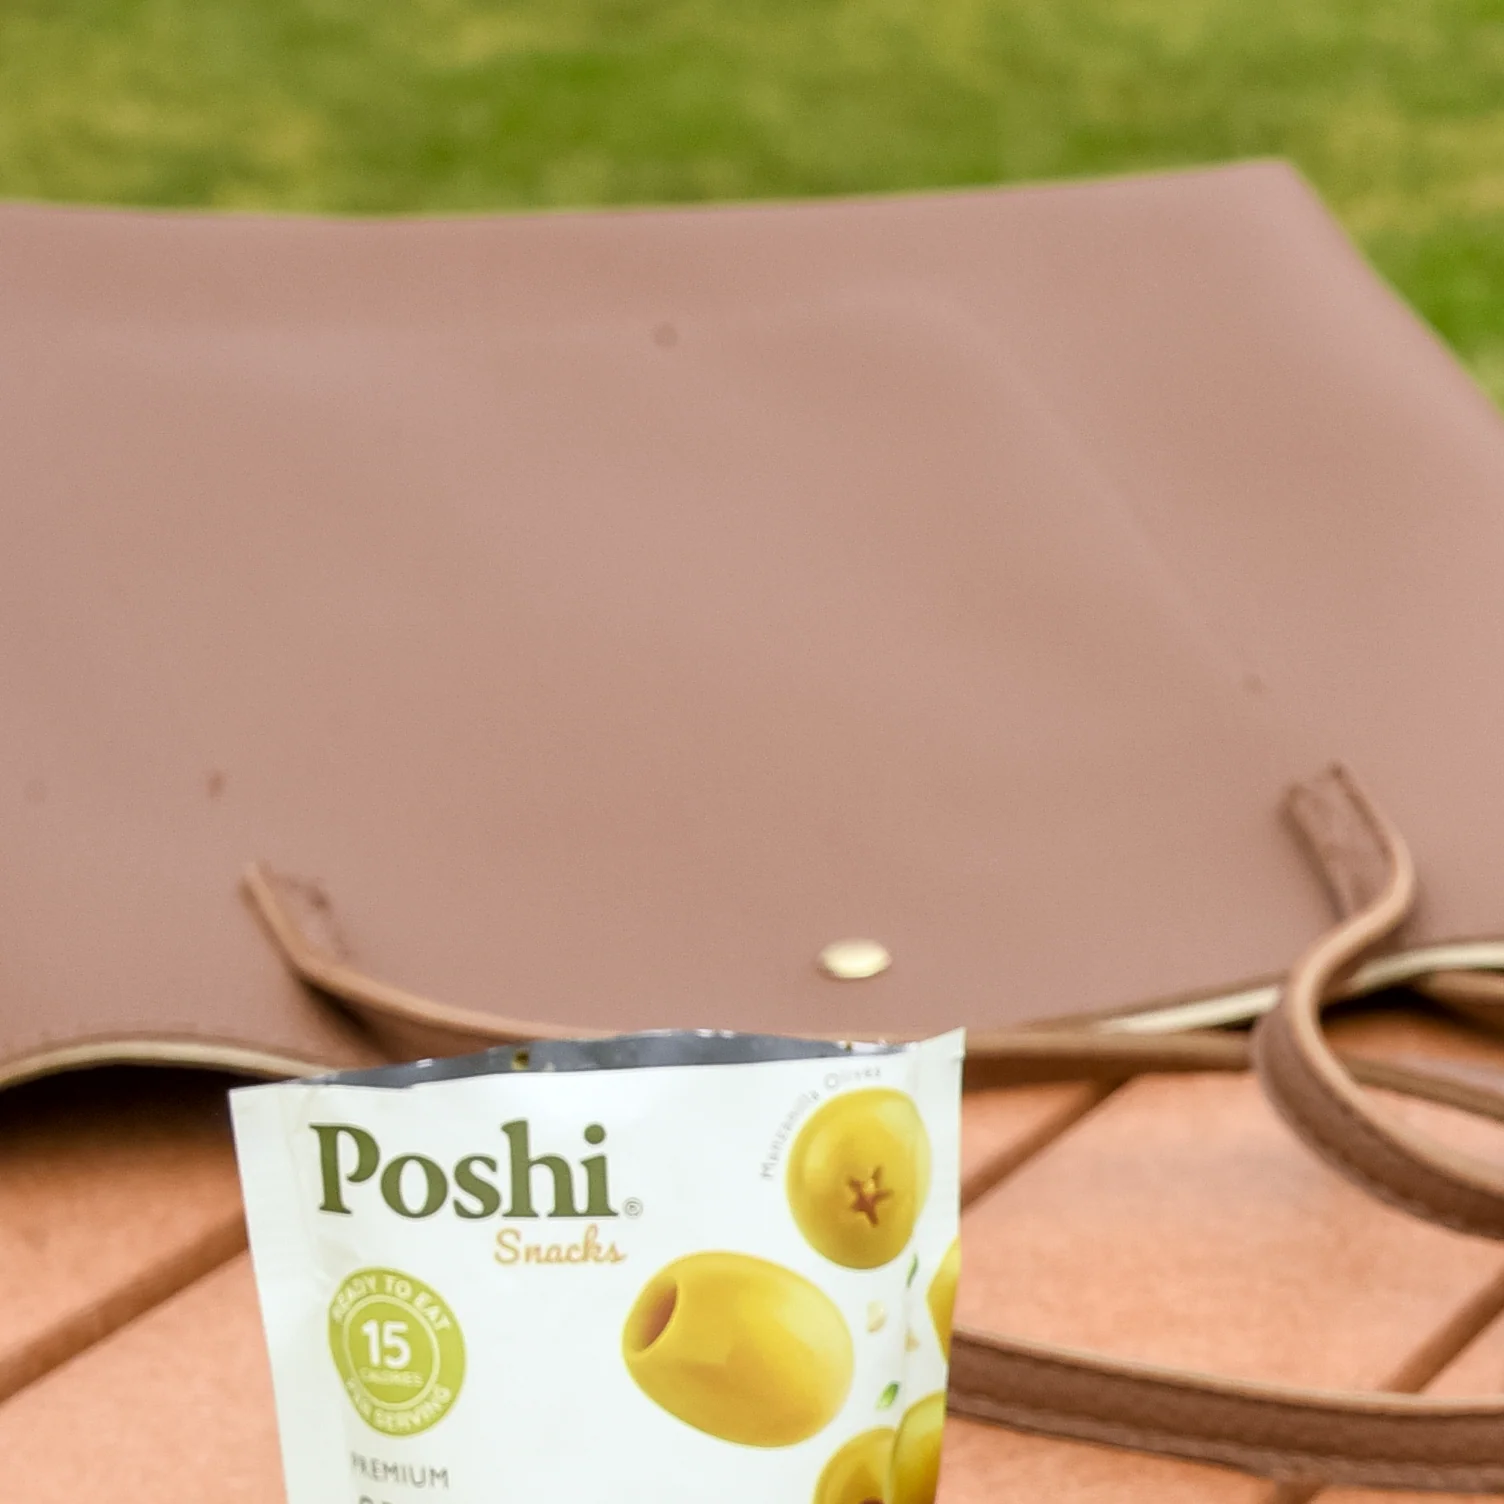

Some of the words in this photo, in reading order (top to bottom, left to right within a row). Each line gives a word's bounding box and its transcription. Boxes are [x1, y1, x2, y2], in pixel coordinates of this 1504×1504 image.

[309, 1120, 620, 1219] Poshi
[494, 1223, 627, 1265] Snacks
[384, 1274, 413, 1300] TO
[413, 1291, 452, 1330] EAT
[361, 1318, 412, 1370] 15
[351, 1451, 450, 1489] PREMIUM
